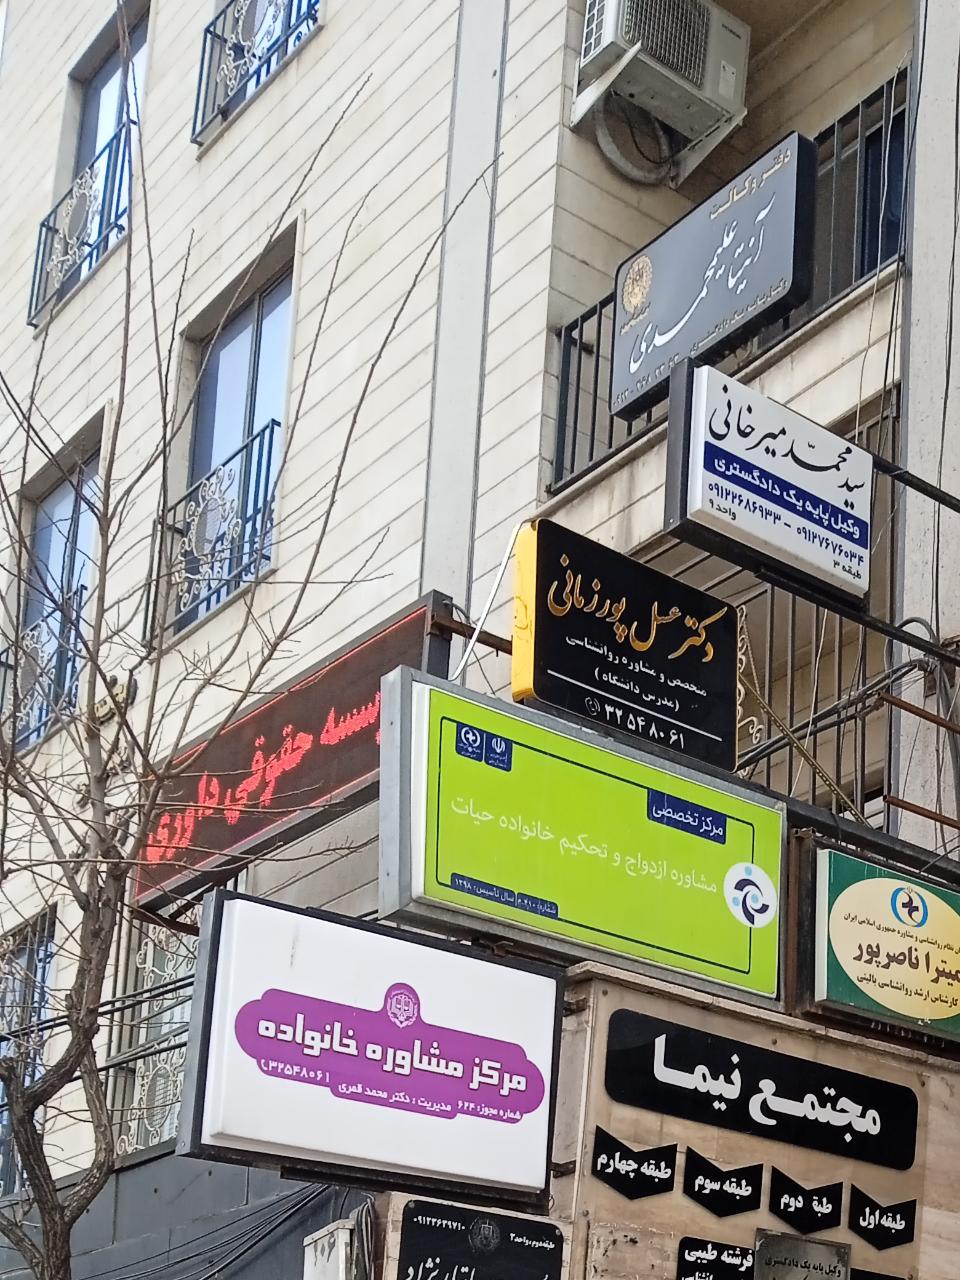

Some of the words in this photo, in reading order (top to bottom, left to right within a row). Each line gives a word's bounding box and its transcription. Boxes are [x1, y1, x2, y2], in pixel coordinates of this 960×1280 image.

[761, 150, 791, 185] دفتر
[709, 174, 758, 220] وکالت
[709, 384, 786, 457] میرخانی
[714, 458, 780, 496] دادگستری
[709, 499, 714, 508] ۹
[783, 491, 803, 511] یک
[838, 477, 865, 510] سید
[716, 503, 736, 521] واحد
[806, 501, 830, 526] پایه
[831, 517, 860, 539] وکیل
[842, 564, 861, 579] طبقه
[668, 606, 727, 662] دکتر
[565, 635, 619, 664] روانشناسی
[622, 657, 656, 677] مشاوره
[659, 673, 665, 683] و
[451, 798, 494, 825] حیات
[652, 801, 699, 827] تخصصی
[499, 815, 555, 841] خانواده
[700, 817, 724, 841] مرکز
[559, 833, 608, 859] تحکیم
[612, 853, 621, 866] و
[625, 855, 667, 881] ازدواج
[671, 868, 717, 894] مشاوره
[843, 913, 857, 924] ایران
[857, 974, 877, 986] بالینی
[878, 979, 913, 996] روانشناسی
[914, 987, 930, 1000] ارشد
[930, 994, 958, 1008] کارشناس
[258, 1013, 359, 1056] خانواده
[366, 1039, 463, 1080] مشاوره
[266, 1060, 330, 1083] ۳۲۵۴۸۰۶۱
[469, 1057, 527, 1096] مرکز
[653, 1033, 741, 1111] نیما
[338, 1082, 362, 1095] قمری
[364, 1088, 388, 1100] محمد
[389, 1092, 412, 1106] دکتر
[418, 1096, 452, 1112] مدیریت
[749, 1078, 881, 1142] مجتمع
[499, 1109, 521, 1121] شماره
[597, 1151, 638, 1179] چهارم
[639, 1159, 672, 1182] طبقه
[695, 1173, 721, 1194] سوم
[722, 1178, 752, 1197] طبقه
[780, 1192, 803, 1210] دوم
[859, 1208, 879, 1229] اول
[880, 1215, 905, 1233] طبقه
[684, 1243, 717, 1264] طیبی
[721, 1247, 753, 1271] فرشته
[765, 1256, 800, 1269] دادگستری
[801, 1260, 811, 1272] یک
[813, 1263, 824, 1275] پایه
[827, 1262, 841, 1277] وکیل
